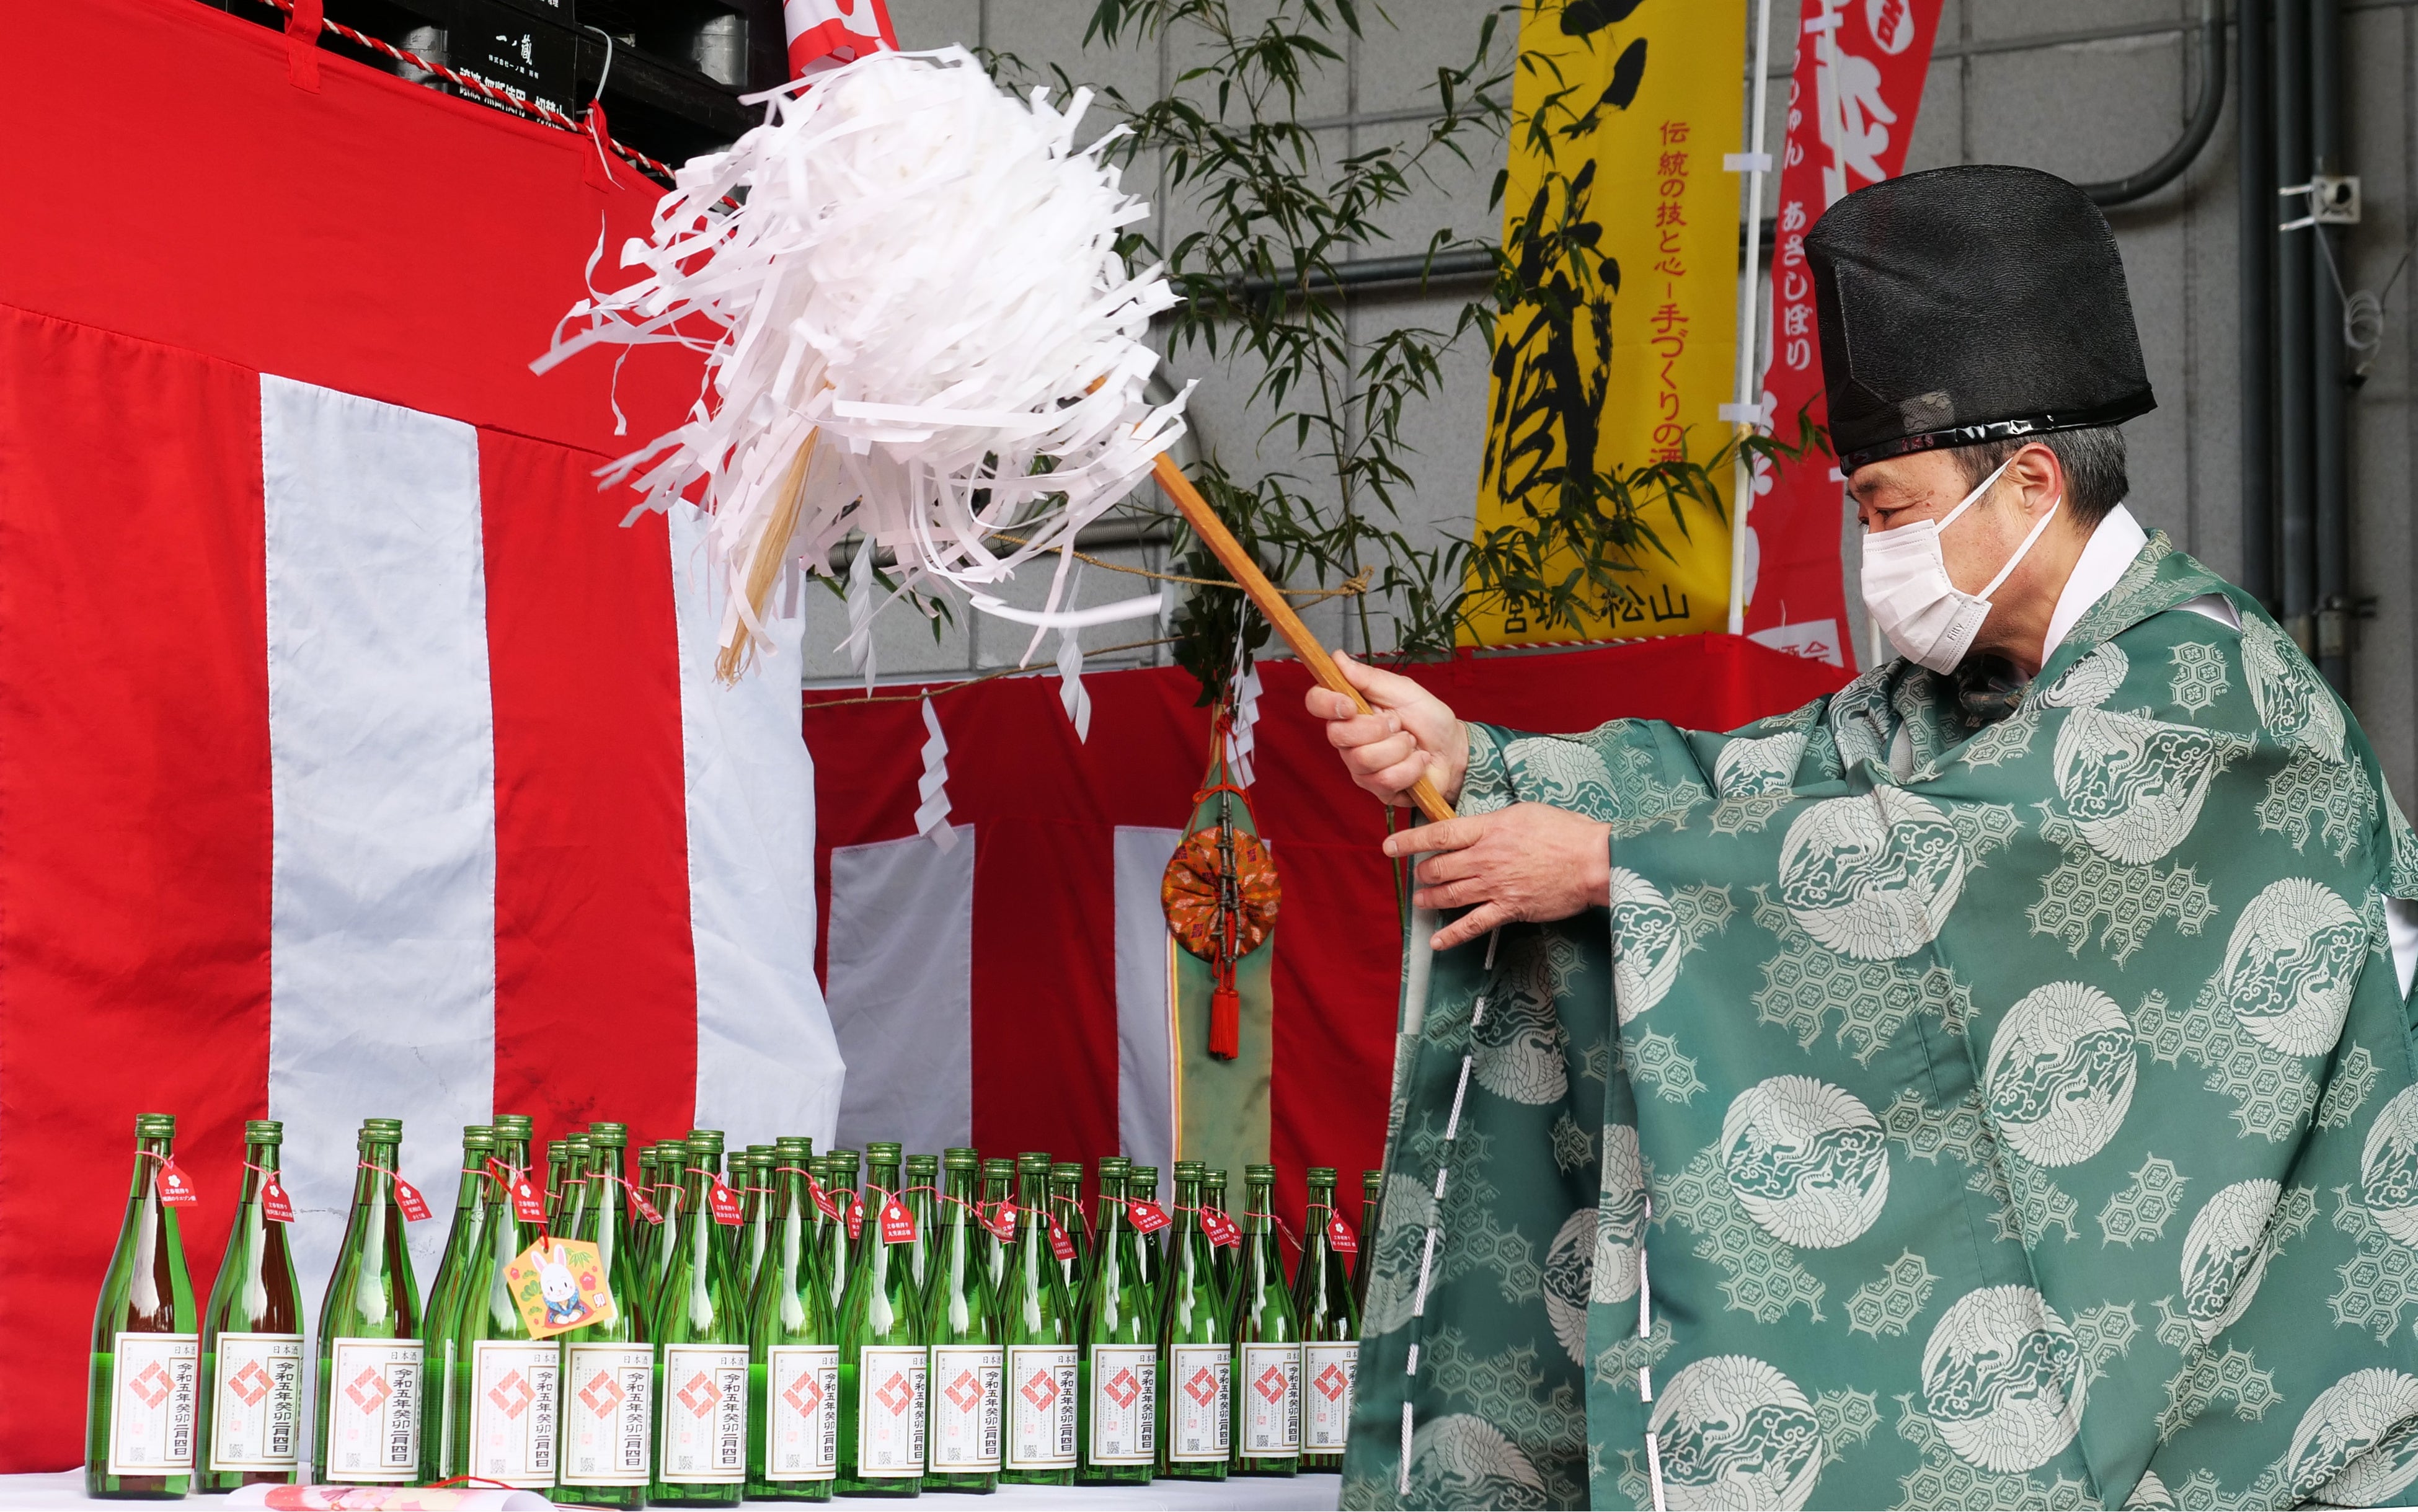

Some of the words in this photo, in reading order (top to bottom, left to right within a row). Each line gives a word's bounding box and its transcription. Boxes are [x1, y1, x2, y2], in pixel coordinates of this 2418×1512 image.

[495, 34, 533, 65] 一ノ蔵
[1782, 201, 1813, 371] あさしぼり
[175, 1345, 196, 1355] 日本酒
[273, 1345, 298, 1355] 日本酒
[391, 1351, 417, 1361] 日本酒
[535, 1353, 556, 1363] 日本酒
[624, 1355, 648, 1364] 日本酒
[720, 1356, 744, 1365] 日本酒
[174, 1363, 193, 1456] 令和五年癸卯二月四日
[273, 1362, 294, 1453] 令和五年癸卯二月四日
[391, 1369, 413, 1462] 令和五年癸卯二月四日
[535, 1371, 553, 1467] 令和五年癸卯二月四日
[624, 1373, 645, 1466] 令和五年癸卯二月四日
[721, 1374, 740, 1464] 令和五年癸卯二月四日
[823, 1373, 836, 1461] 令和五年癸卯二月四日
[913, 1373, 925, 1459] 令和五年癸卯二月四日
[985, 1371, 999, 1455] 令和五年癸卯二月四日
[1060, 1370, 1074, 1452] 令和五年癸卯二月四日
[1141, 1369, 1153, 1449] 令和五年癸卯二月四日
[1218, 1368, 1229, 1445] 令和五年癸卯二月四日
[1288, 1366, 1298, 1442] 令和五年癸卯二月四日
